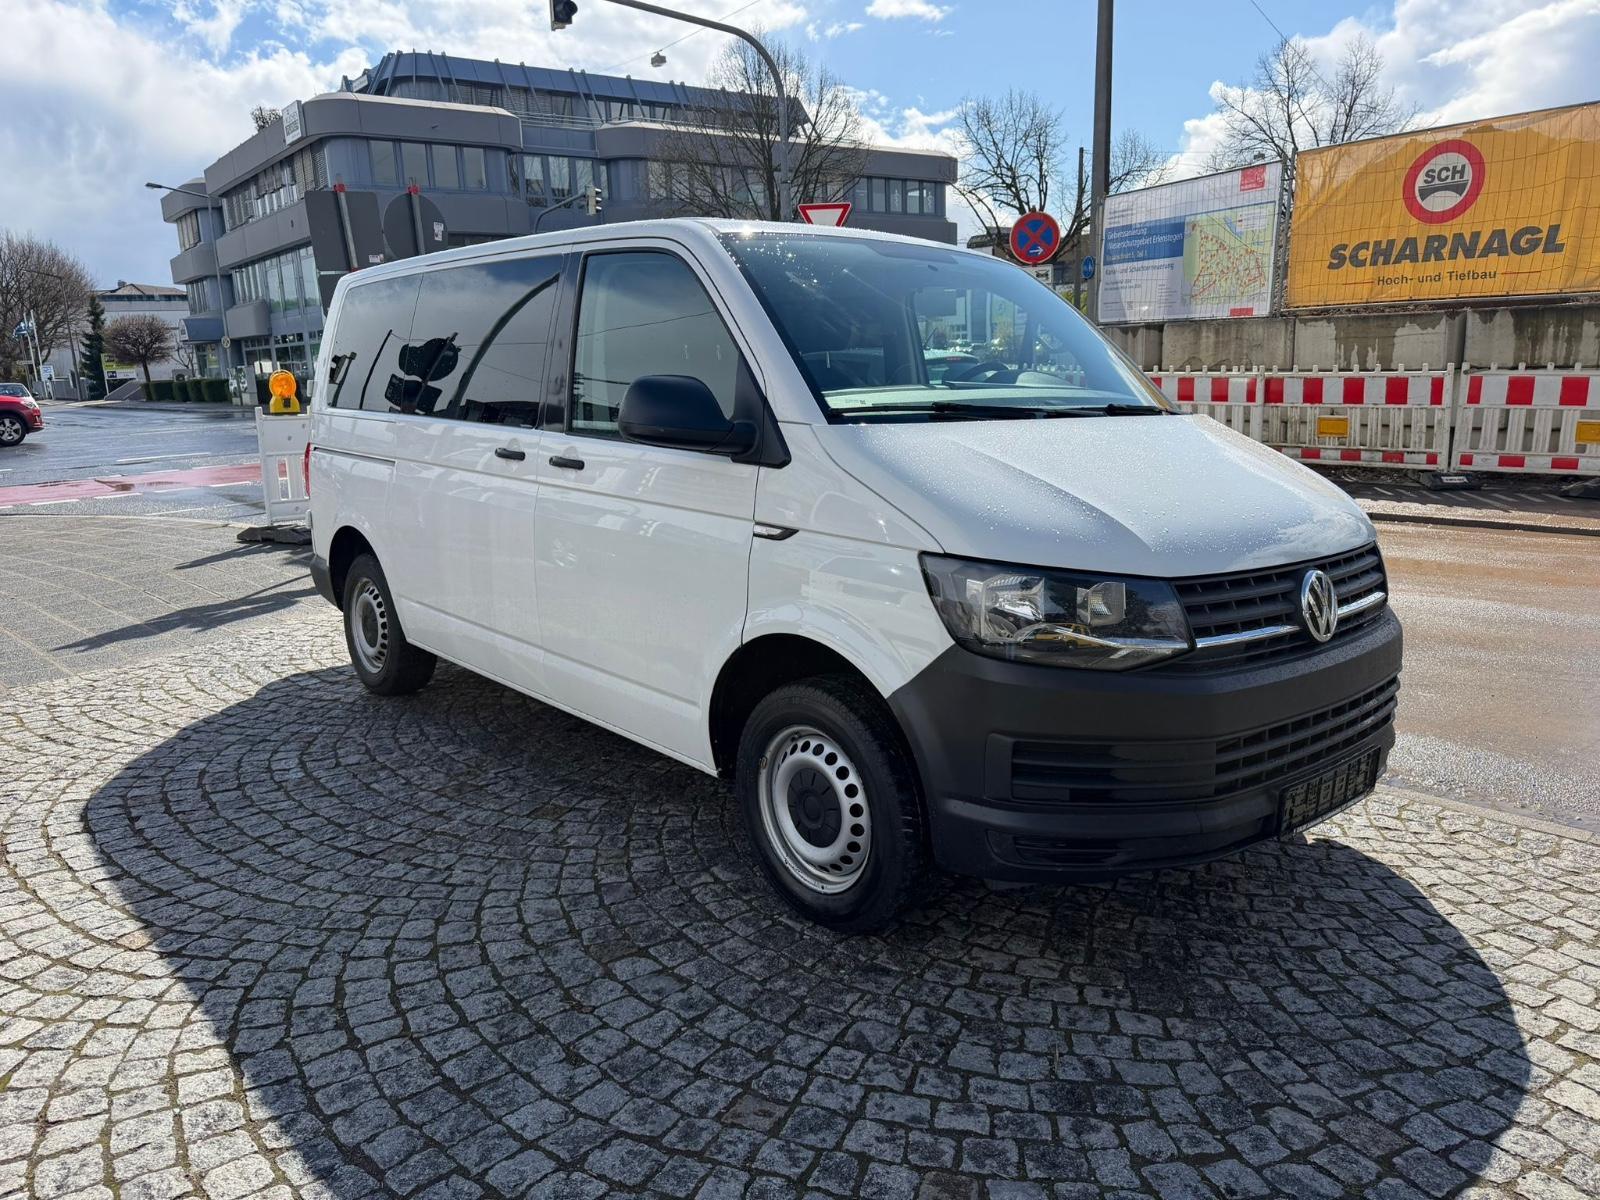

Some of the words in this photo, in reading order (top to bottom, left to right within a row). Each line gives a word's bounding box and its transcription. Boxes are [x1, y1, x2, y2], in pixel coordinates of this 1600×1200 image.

[1423, 163, 1466, 185] SCH
[1327, 224, 1566, 270] SCHARNAGL
[1377, 274, 1413, 286] Hoch-
[1417, 272, 1442, 283] und
[1448, 270, 1497, 281] Tiefbau
